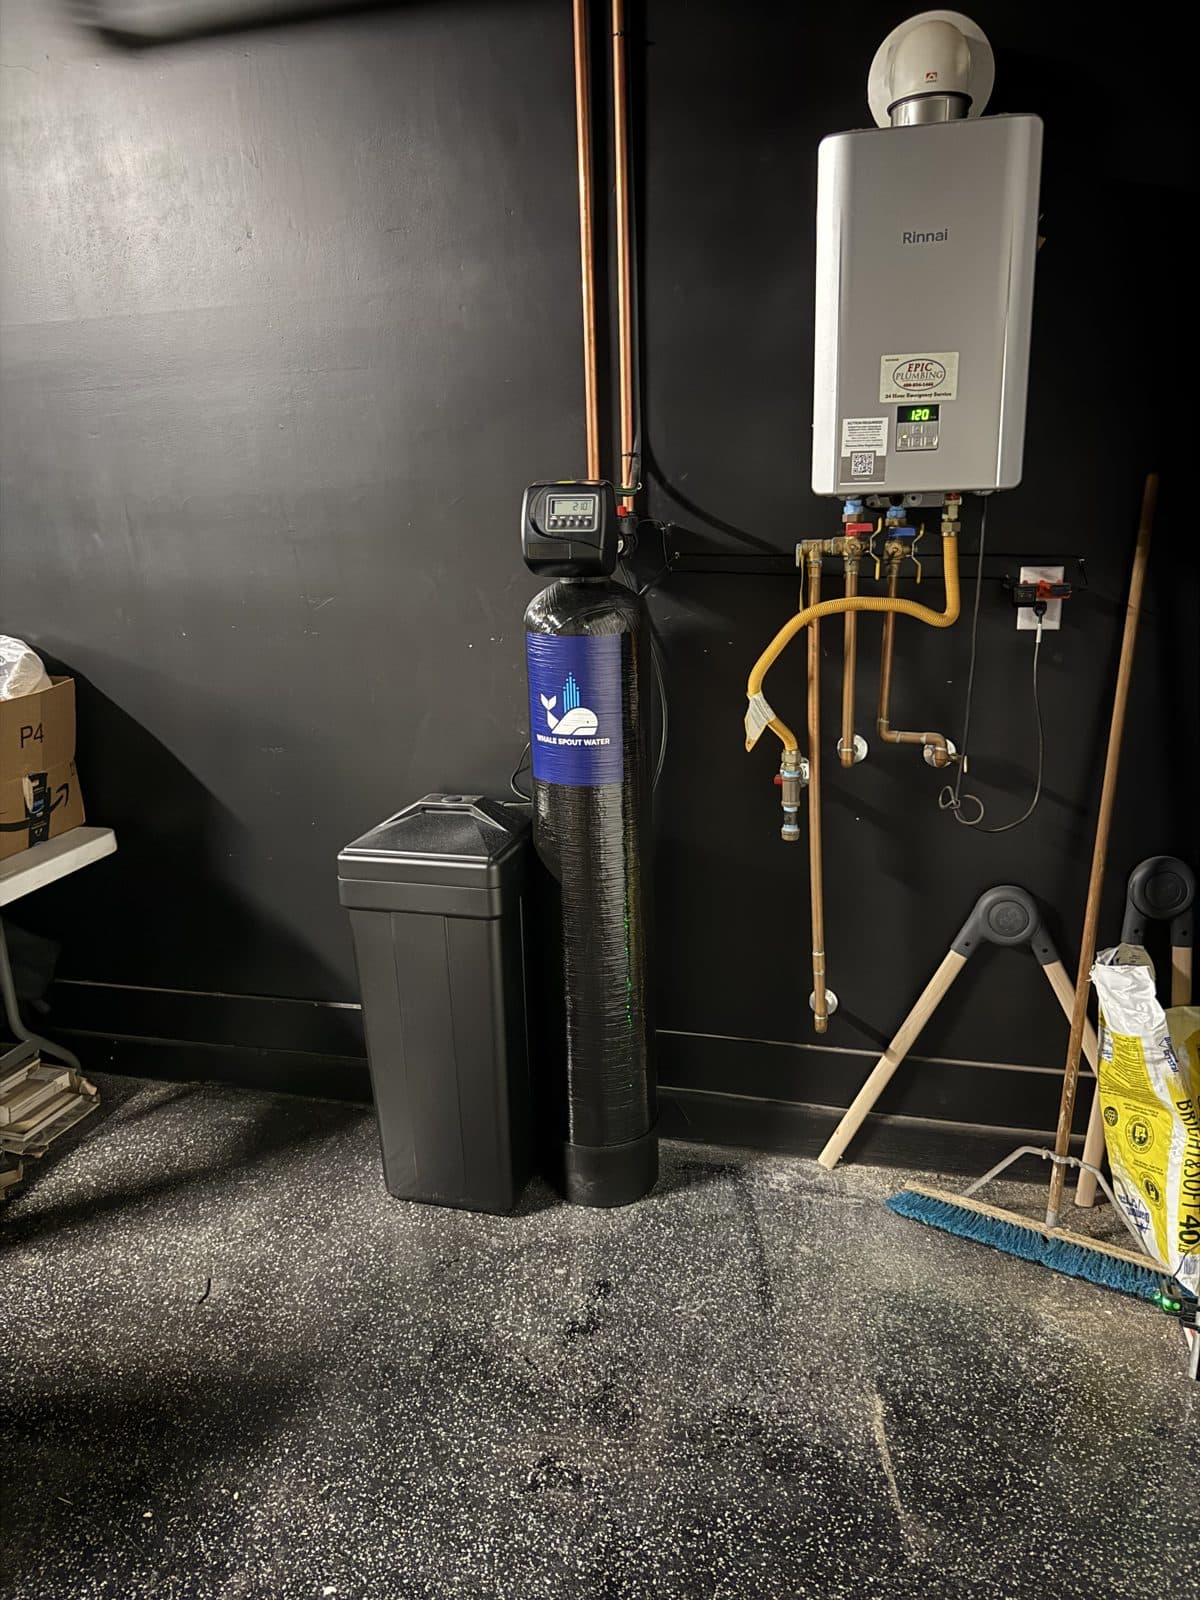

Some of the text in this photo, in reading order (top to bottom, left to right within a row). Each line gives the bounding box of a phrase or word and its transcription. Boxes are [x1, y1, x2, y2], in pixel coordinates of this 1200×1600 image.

[903, 228, 948, 244] Rinnai
[907, 362, 934, 373] EPIC
[895, 370, 944, 381] PLUMBING
[911, 409, 930, 421] 120
[20, 723, 44, 749] P4
[536, 733, 610, 746] WHALE SPOUT WATER
[1178, 1214, 1200, 1245] 40
